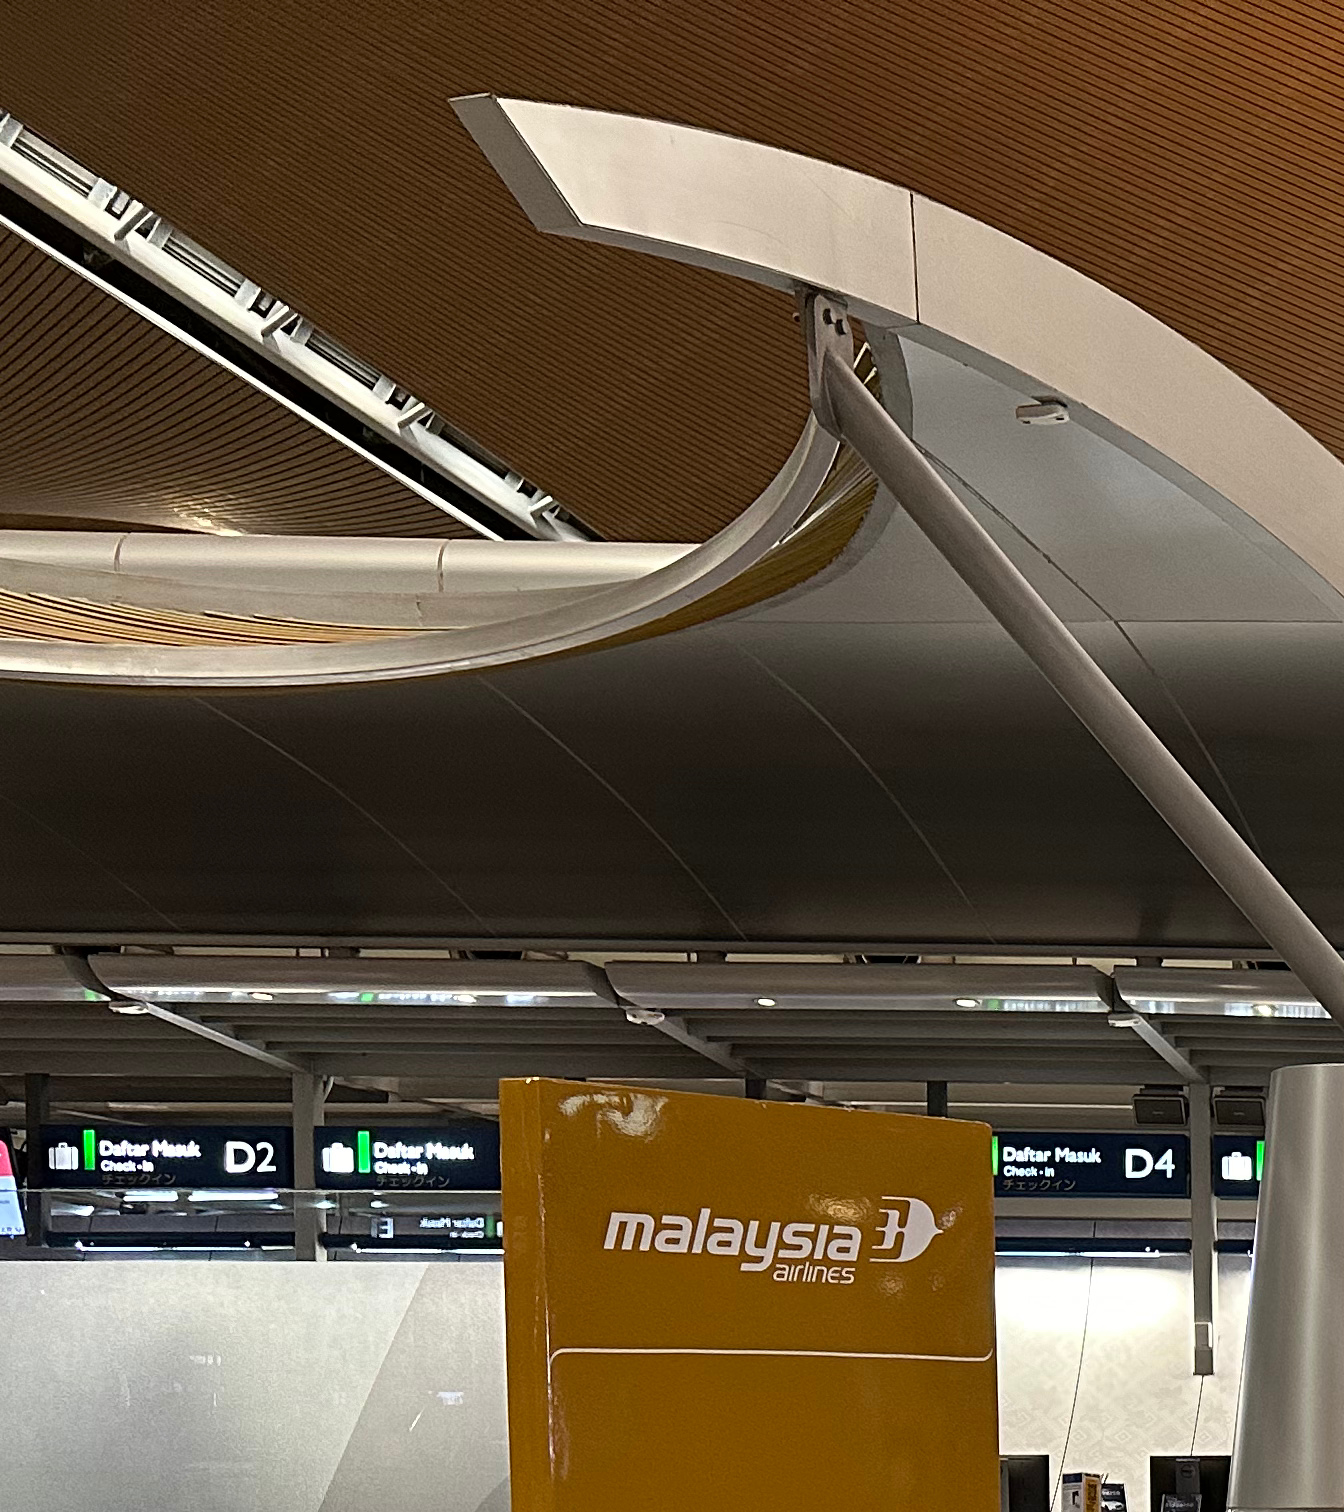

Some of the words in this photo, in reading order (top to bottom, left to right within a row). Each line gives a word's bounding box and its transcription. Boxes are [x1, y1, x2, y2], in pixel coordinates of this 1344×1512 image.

[99, 1140, 149, 1156] Daftar
[152, 1140, 201, 1157] Masuk
[225, 1141, 277, 1173] D2
[373, 1142, 423, 1159] Daftar
[426, 1142, 474, 1159] Masuk
[1003, 1147, 1051, 1162] Daftar
[1055, 1147, 1101, 1163] Masuk
[1125, 1148, 1175, 1179] D4
[604, 1208, 862, 1272] malaysia
[773, 1262, 856, 1284] airlines
